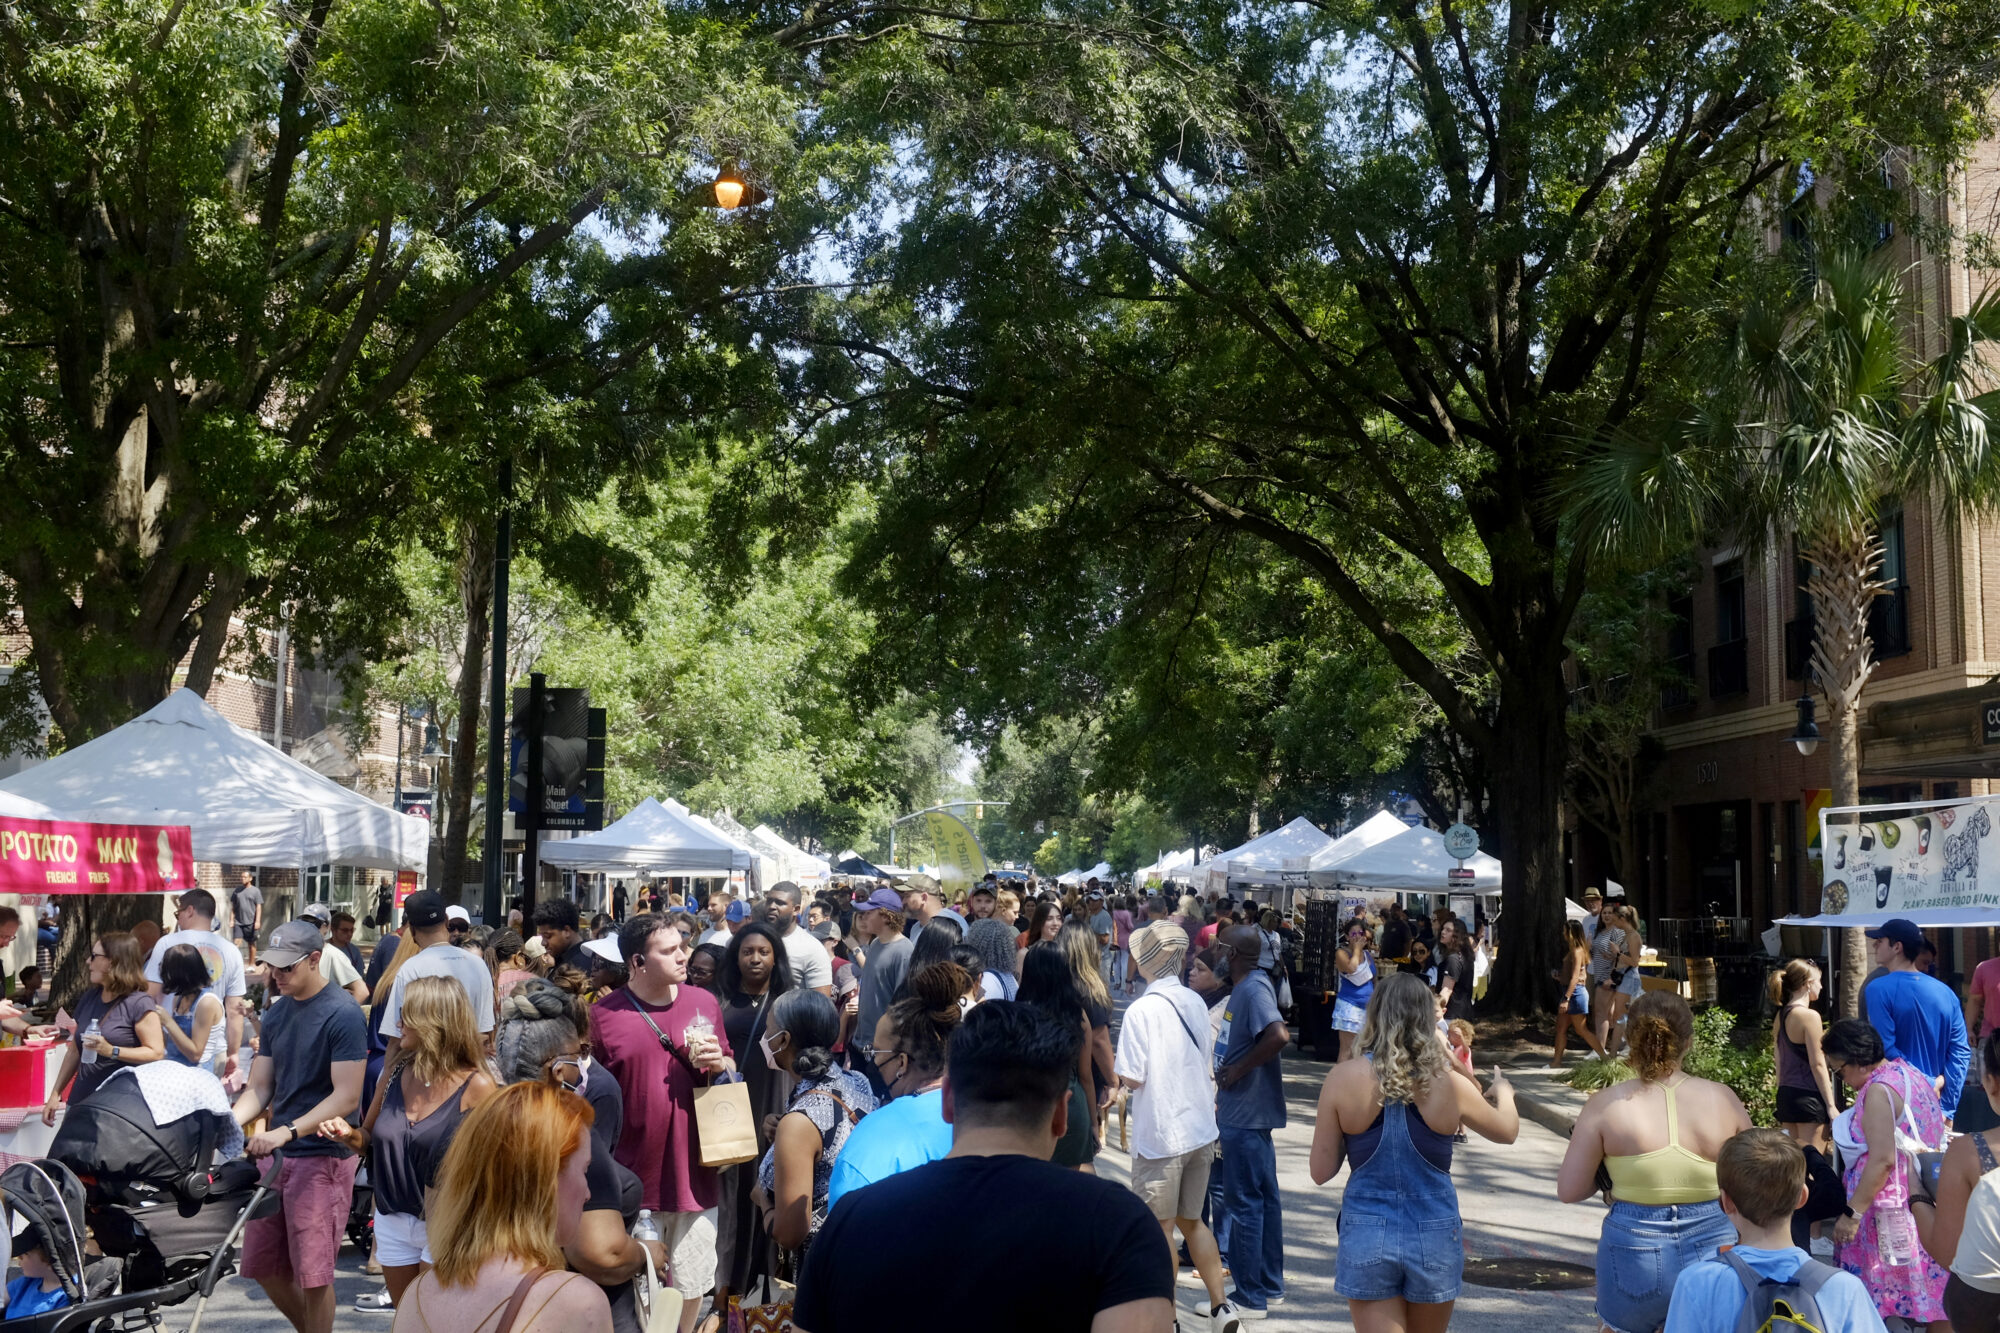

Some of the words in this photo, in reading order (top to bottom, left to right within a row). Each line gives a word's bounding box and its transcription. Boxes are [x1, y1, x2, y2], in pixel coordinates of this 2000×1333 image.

[1696, 760, 1718, 784] 1520
[546, 785, 566, 796] Main
[545, 798, 569, 810] Street
[577, 818, 585, 826] SC
[1, 830, 78, 863] POTATO
[97, 837, 139, 864] MAN
[1852, 862, 1870, 873] GLUTEN
[46, 871, 77, 884] FRENCH
[88, 871, 111, 884] FRIES
[1855, 874, 1868, 882] FREE
[1906, 873, 1918, 881] FREE
[1901, 897, 1950, 909] PLANT-BASED
[1951, 895, 1971, 906] FOOD
